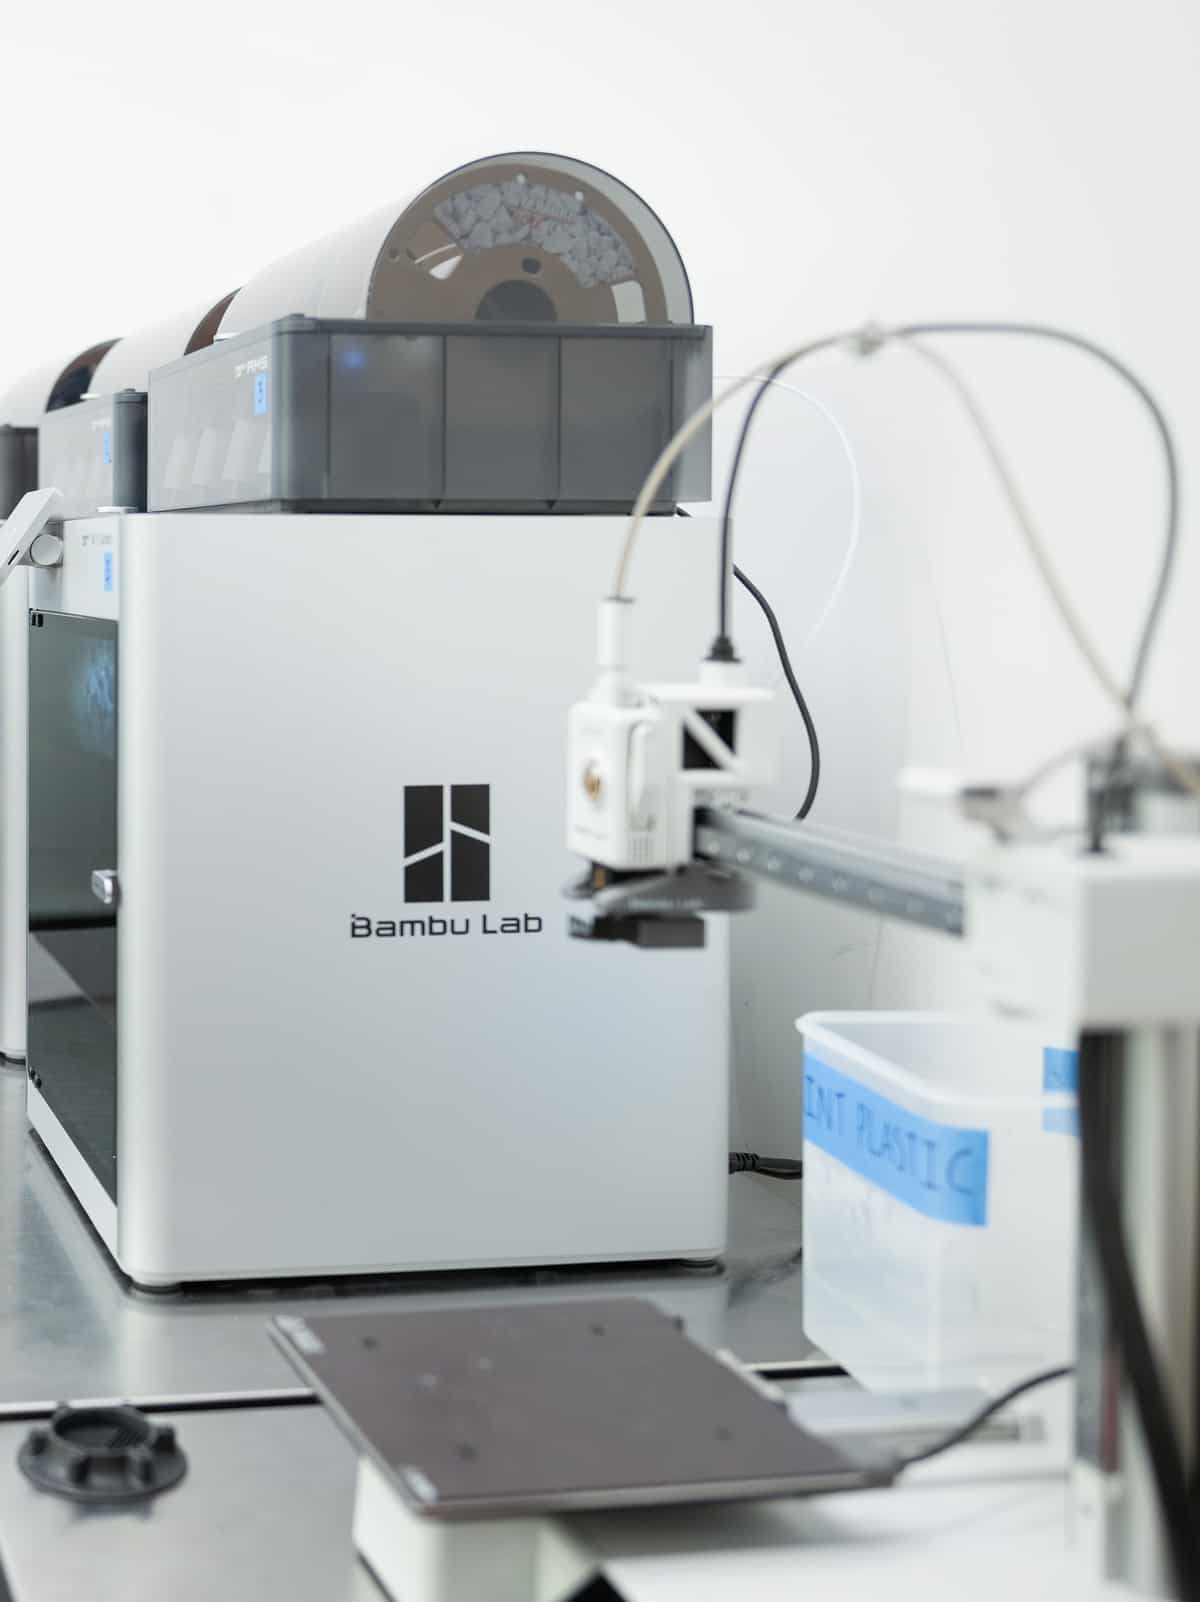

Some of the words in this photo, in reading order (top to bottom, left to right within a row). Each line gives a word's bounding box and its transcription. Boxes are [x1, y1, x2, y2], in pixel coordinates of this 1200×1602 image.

[351, 914, 469, 938] Bambu
[483, 912, 543, 935] Lab
[856, 1103, 974, 1195] PLASTIC
